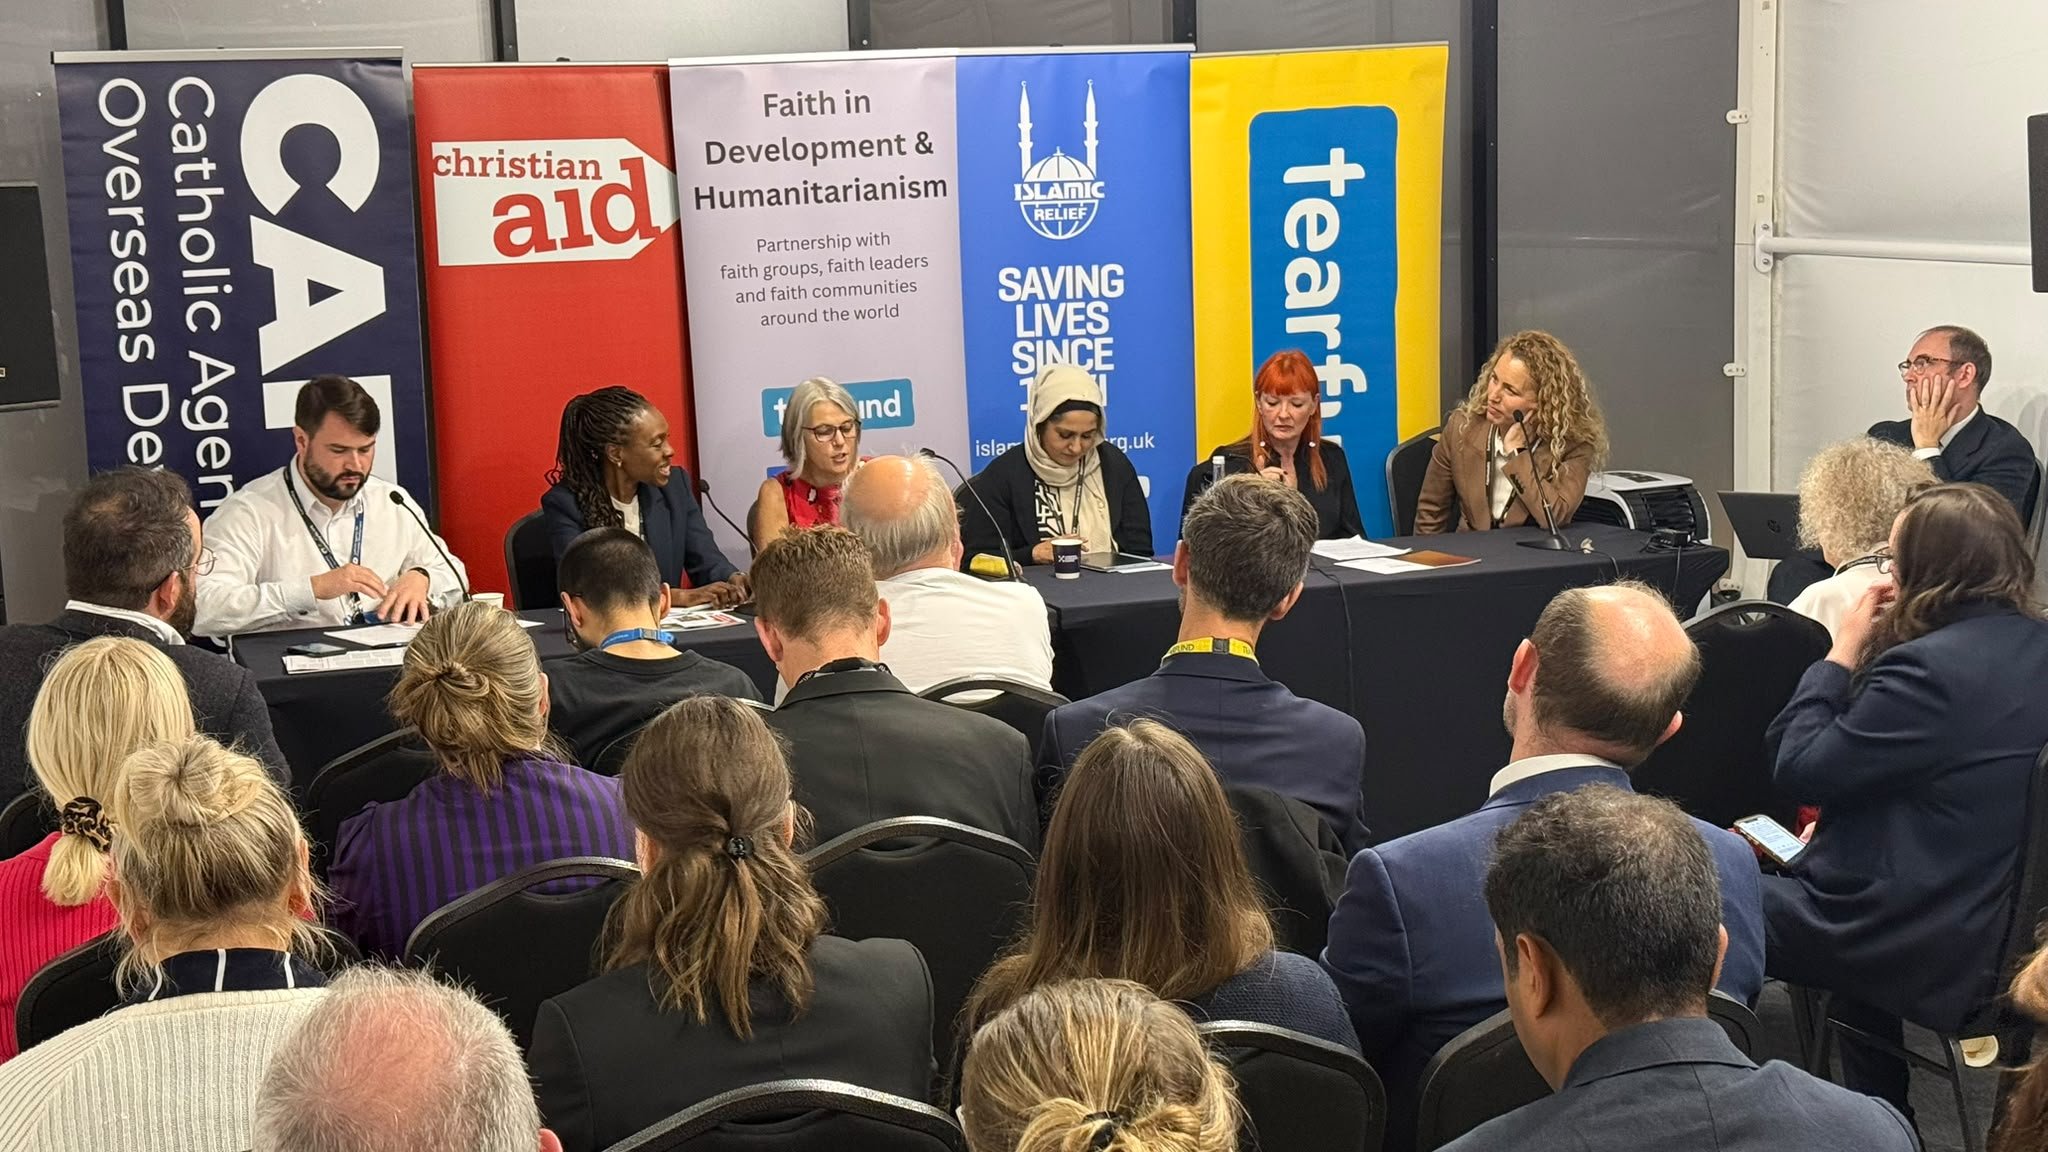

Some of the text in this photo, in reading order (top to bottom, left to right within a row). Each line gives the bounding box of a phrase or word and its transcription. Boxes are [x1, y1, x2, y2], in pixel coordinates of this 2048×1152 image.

[763, 88, 871, 118] Faith in
[433, 148, 602, 180] christian
[705, 131, 934, 167] Development &
[493, 157, 661, 257] aid
[694, 174, 948, 210] Humanitarianism
[1014, 181, 1105, 201] ISLAMIC
[1034, 207, 1087, 222] RELIEF
[757, 232, 890, 253] Partnership with
[99, 77, 170, 472] Overseas De
[720, 254, 929, 281] faith groups, faith leaders
[998, 263, 1125, 302] SAVING
[168, 76, 236, 508] Catholic Agen
[735, 279, 917, 303] and faith communities
[760, 303, 900, 326] around the world
[1016, 301, 1109, 338] LIVES
[1012, 337, 1115, 375] SINCE
